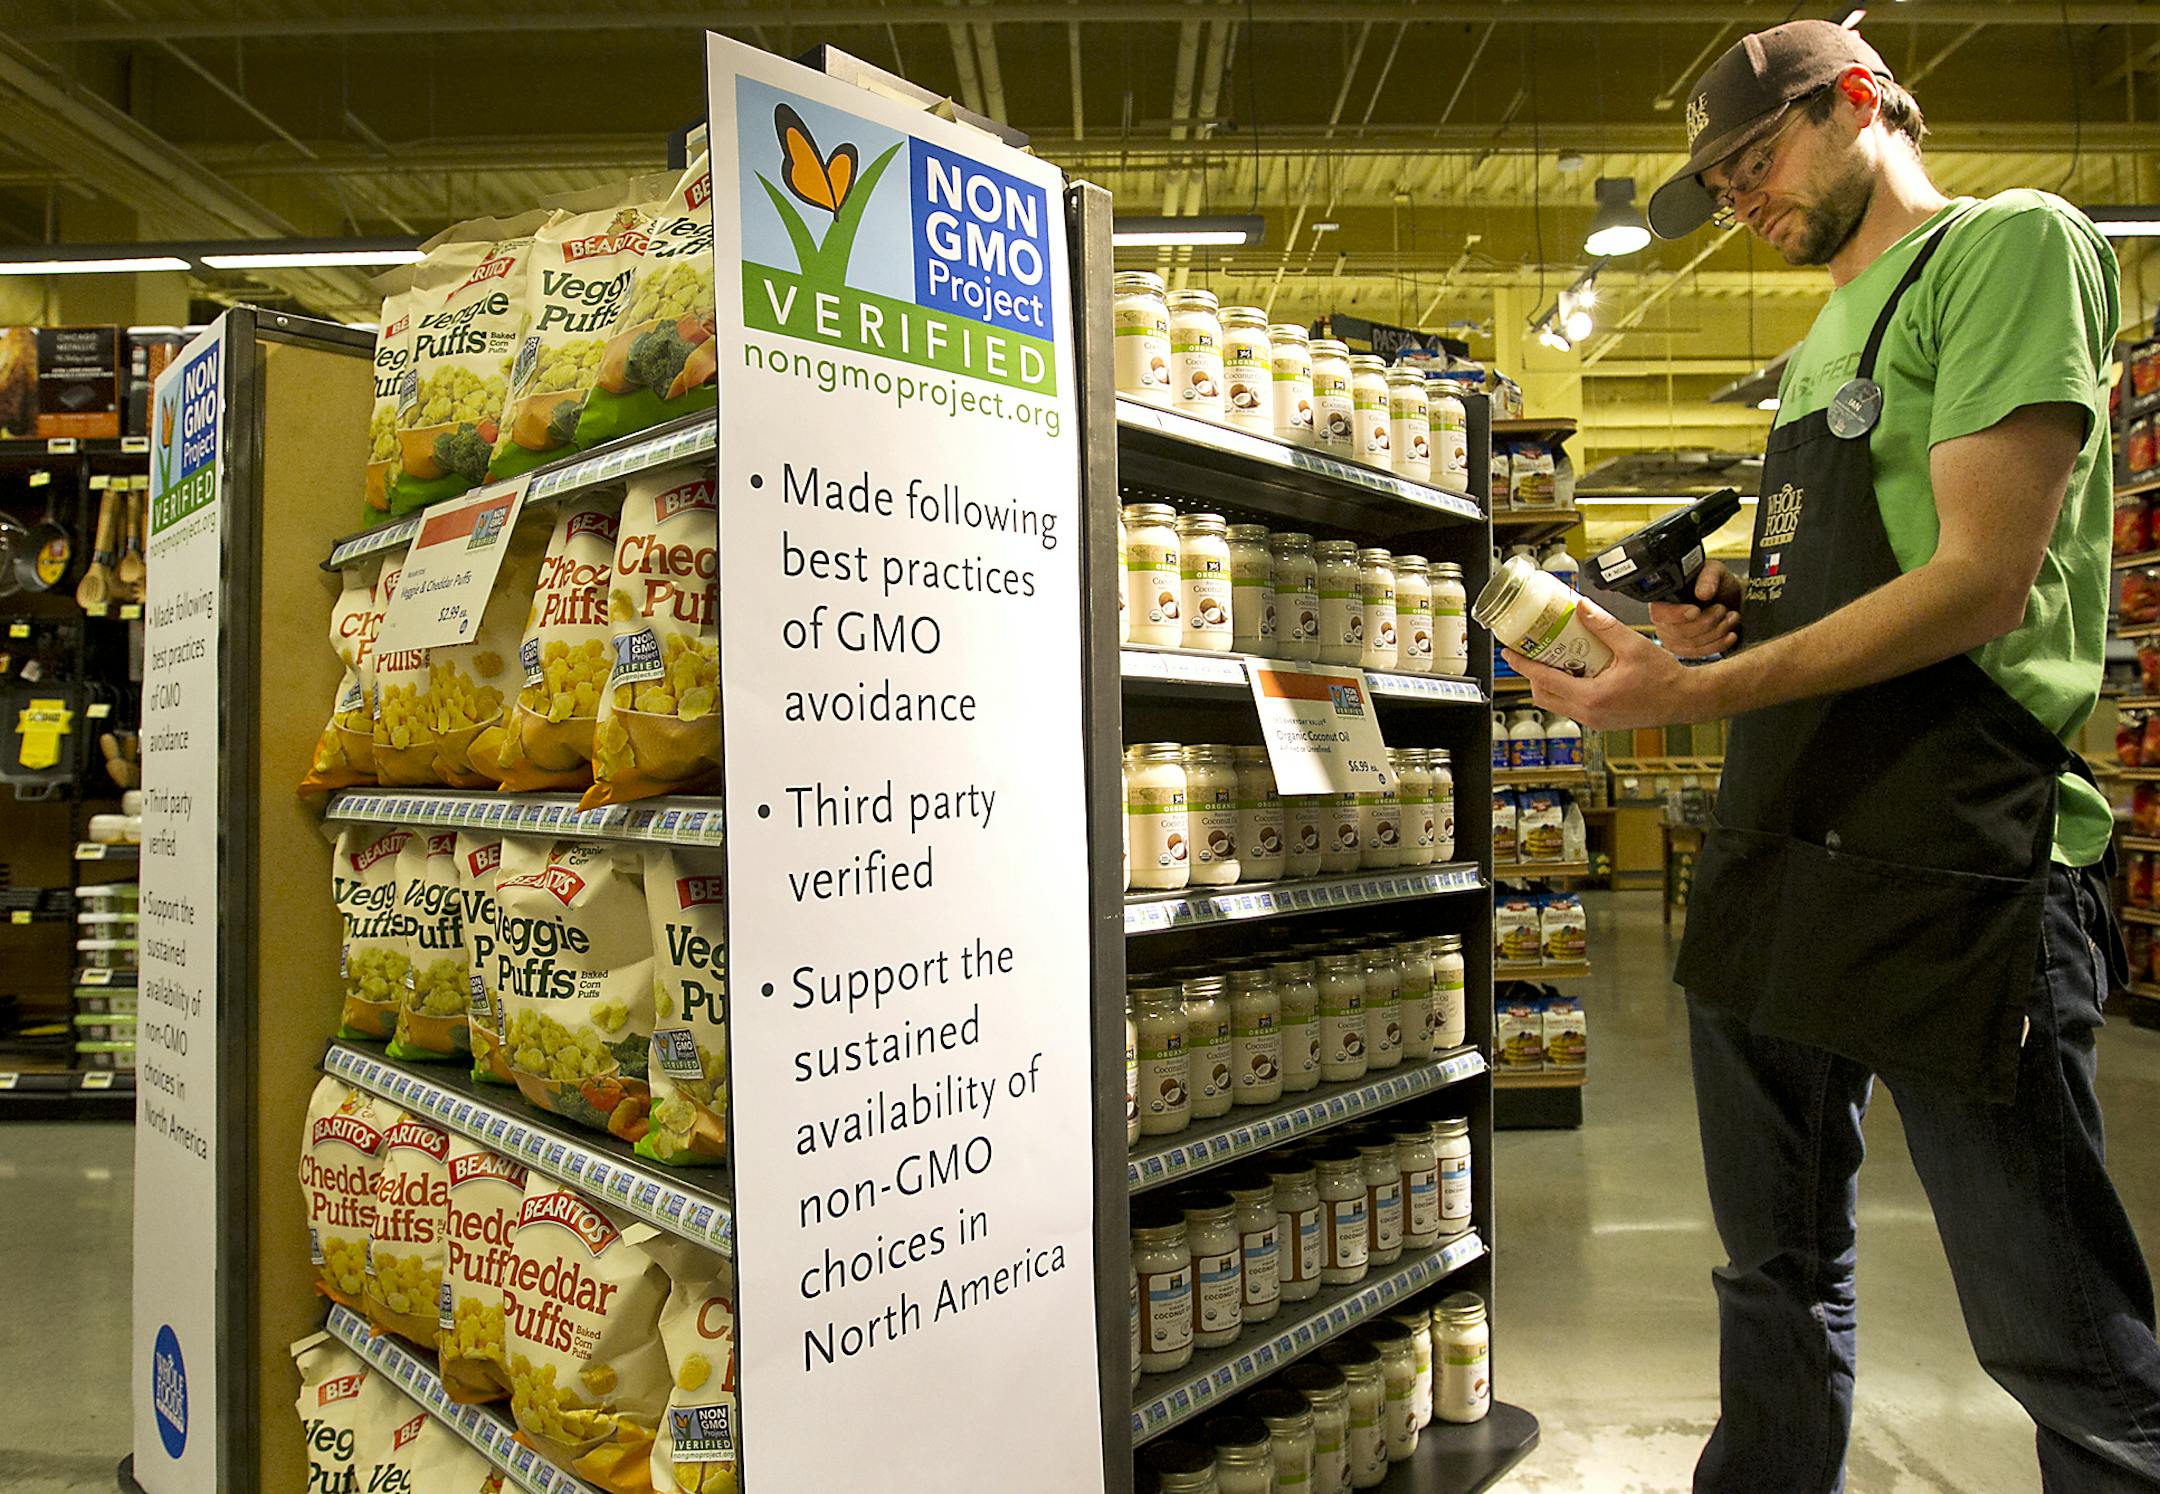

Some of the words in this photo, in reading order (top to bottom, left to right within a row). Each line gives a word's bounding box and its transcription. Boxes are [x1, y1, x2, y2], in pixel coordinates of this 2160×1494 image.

[926, 156, 1037, 238] NON
[925, 212, 1043, 286] GMO
[418, 289, 509, 330] Veggie
[929, 260, 1043, 327] Project
[413, 324, 486, 363] Puffs
[764, 279, 1045, 384] VERIFIED
[185, 351, 217, 403] NON
[745, 342, 1060, 438] nongmoproject.org
[184, 389, 216, 439] GMO
[184, 430, 215, 468] Project
[155, 469, 214, 528] VERIFIED
[783, 463, 893, 517] Made
[906, 479, 1057, 550] following
[1768, 485, 1804, 515] WHOLE
[1765, 510, 1800, 537] FOODS
[783, 531, 867, 583] best
[884, 556, 1035, 597] practices
[438, 605, 460, 622] $2.99
[540, 586, 608, 627] Puffs
[632, 642, 656, 654] GMO
[783, 605, 827, 649] of
[837, 610, 941, 654] GMO
[785, 679, 976, 722] avoidance
[150, 723, 189, 752] avoidance
[1277, 730, 1307, 743] Organic
[1308, 731, 1338, 742] Coconut
[1338, 731, 1350, 742] Oil
[1349, 760, 1369, 772] $6.99
[785, 779, 893, 828] Third
[911, 785, 996, 834] party
[789, 846, 933, 901] verified
[496, 906, 590, 956] Veggie
[147, 938, 186, 967] sustained
[498, 955, 576, 999] Puffs
[578, 990, 600, 999] Puffs
[580, 980, 601, 989] Corn
[581, 970, 608, 979] Baked
[792, 951, 948, 1013] Support
[961, 938, 1013, 980] the
[146, 977, 190, 1020] availability
[145, 1021, 188, 1056] non-GMO
[676, 1041, 693, 1050] GMO
[795, 1003, 979, 1082] sustained
[797, 1074, 995, 1156] availability
[1008, 1053, 1042, 1098] of
[169, 1114, 207, 1160] America
[315, 1119, 376, 1149] BEARITOS
[800, 1136, 992, 1228] non-GMO
[312, 1192, 376, 1227] Puffs
[524, 1196, 611, 1242] BEARITOS
[800, 1225, 945, 1299] choices
[959, 1208, 988, 1245] in
[804, 1292, 920, 1371] North
[934, 1244, 1065, 1321] America
[1154, 1309, 1185, 1320] COCONUT
[1204, 1290, 1233, 1301] COCONUT
[574, 1336, 593, 1349] Corn
[577, 1325, 601, 1339] Baked
[572, 1347, 592, 1360] Puffs
[699, 1408, 726, 1420] NON
[701, 1419, 727, 1429] GMO
[678, 1440, 730, 1450] VERIFIED
